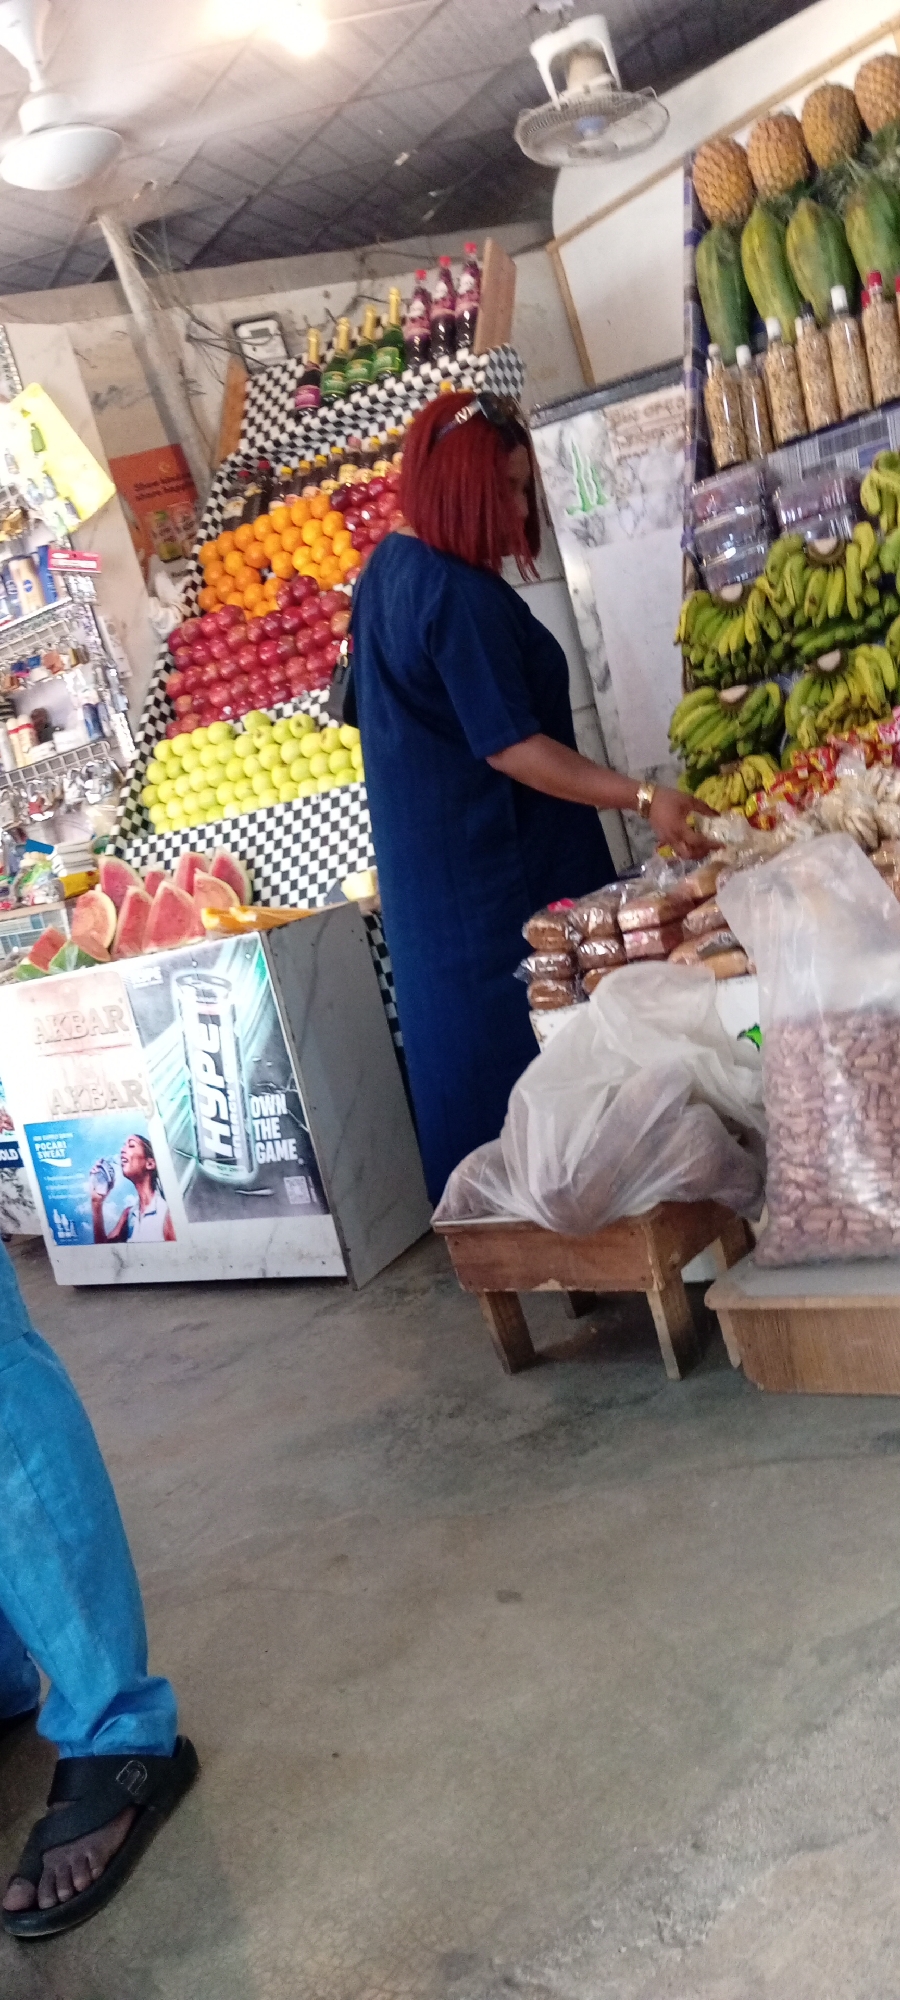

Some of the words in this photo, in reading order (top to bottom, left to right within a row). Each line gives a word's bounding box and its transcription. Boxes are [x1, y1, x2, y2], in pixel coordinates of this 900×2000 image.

[34, 1004, 129, 1044] AKBAR
[51, 1079, 148, 1116] AKBAR
[250, 1093, 287, 1118] OWN
[253, 1116, 282, 1140] THE
[35, 1140, 67, 1151] POCARI
[37, 1149, 66, 1159] SWEAT
